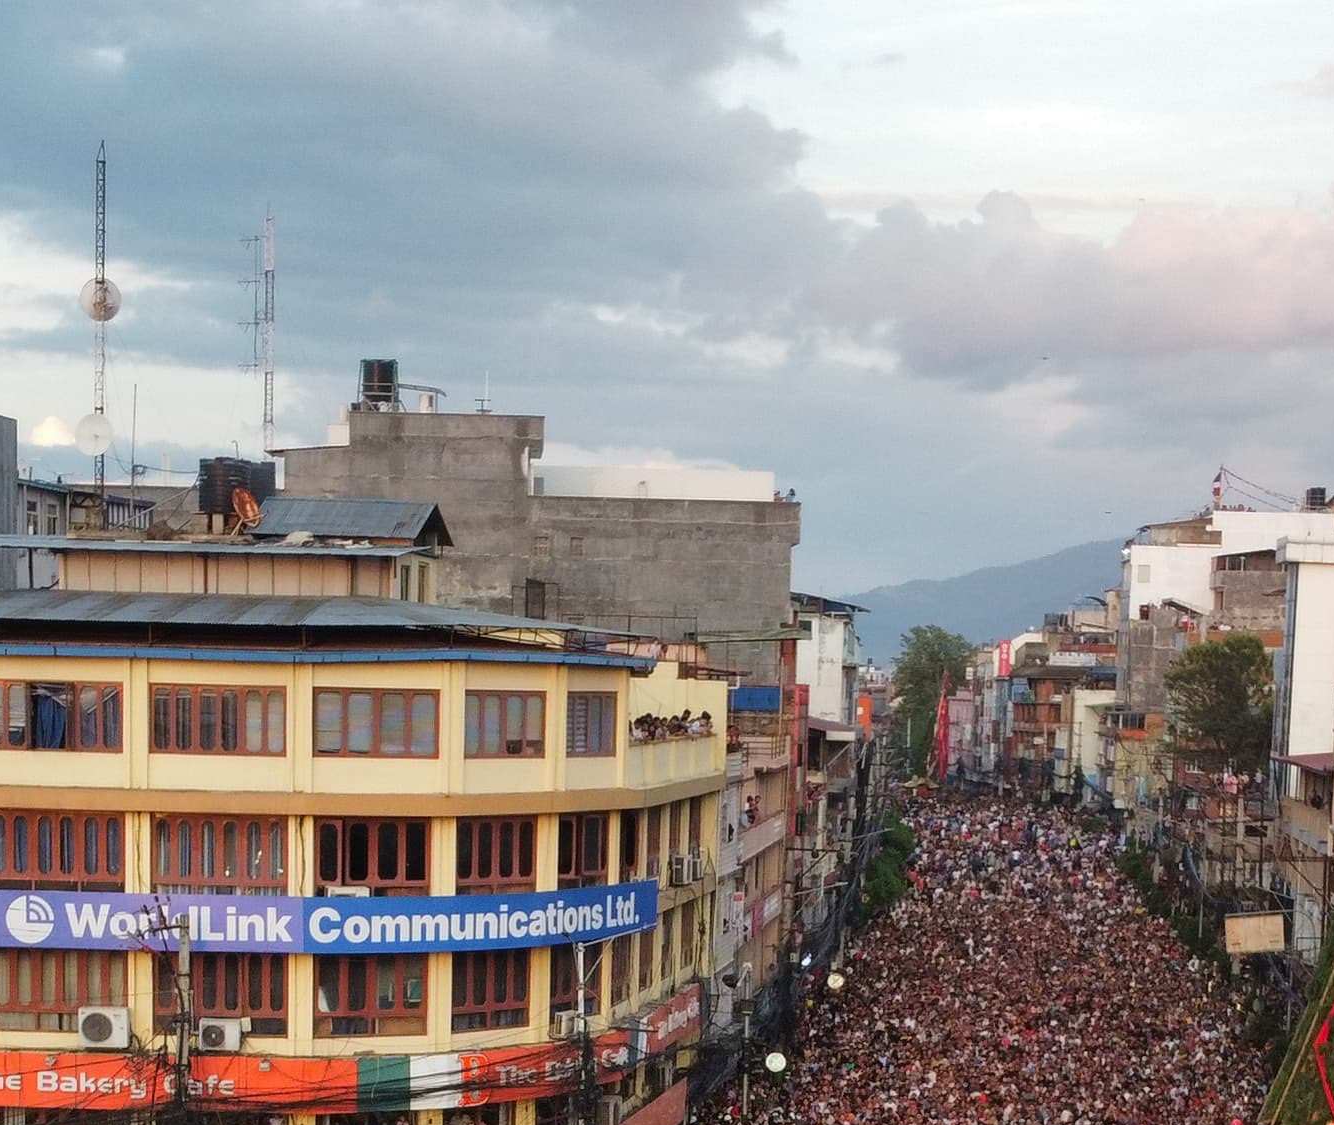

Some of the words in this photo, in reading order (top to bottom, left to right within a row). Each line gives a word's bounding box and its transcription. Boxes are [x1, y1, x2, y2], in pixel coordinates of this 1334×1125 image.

[65, 903, 293, 942] WorldLink
[309, 899, 604, 943] Communications
[606, 892, 640, 929] Ltd.
[37, 1071, 148, 1099] Bakery
[458, 1053, 492, 1108] B
